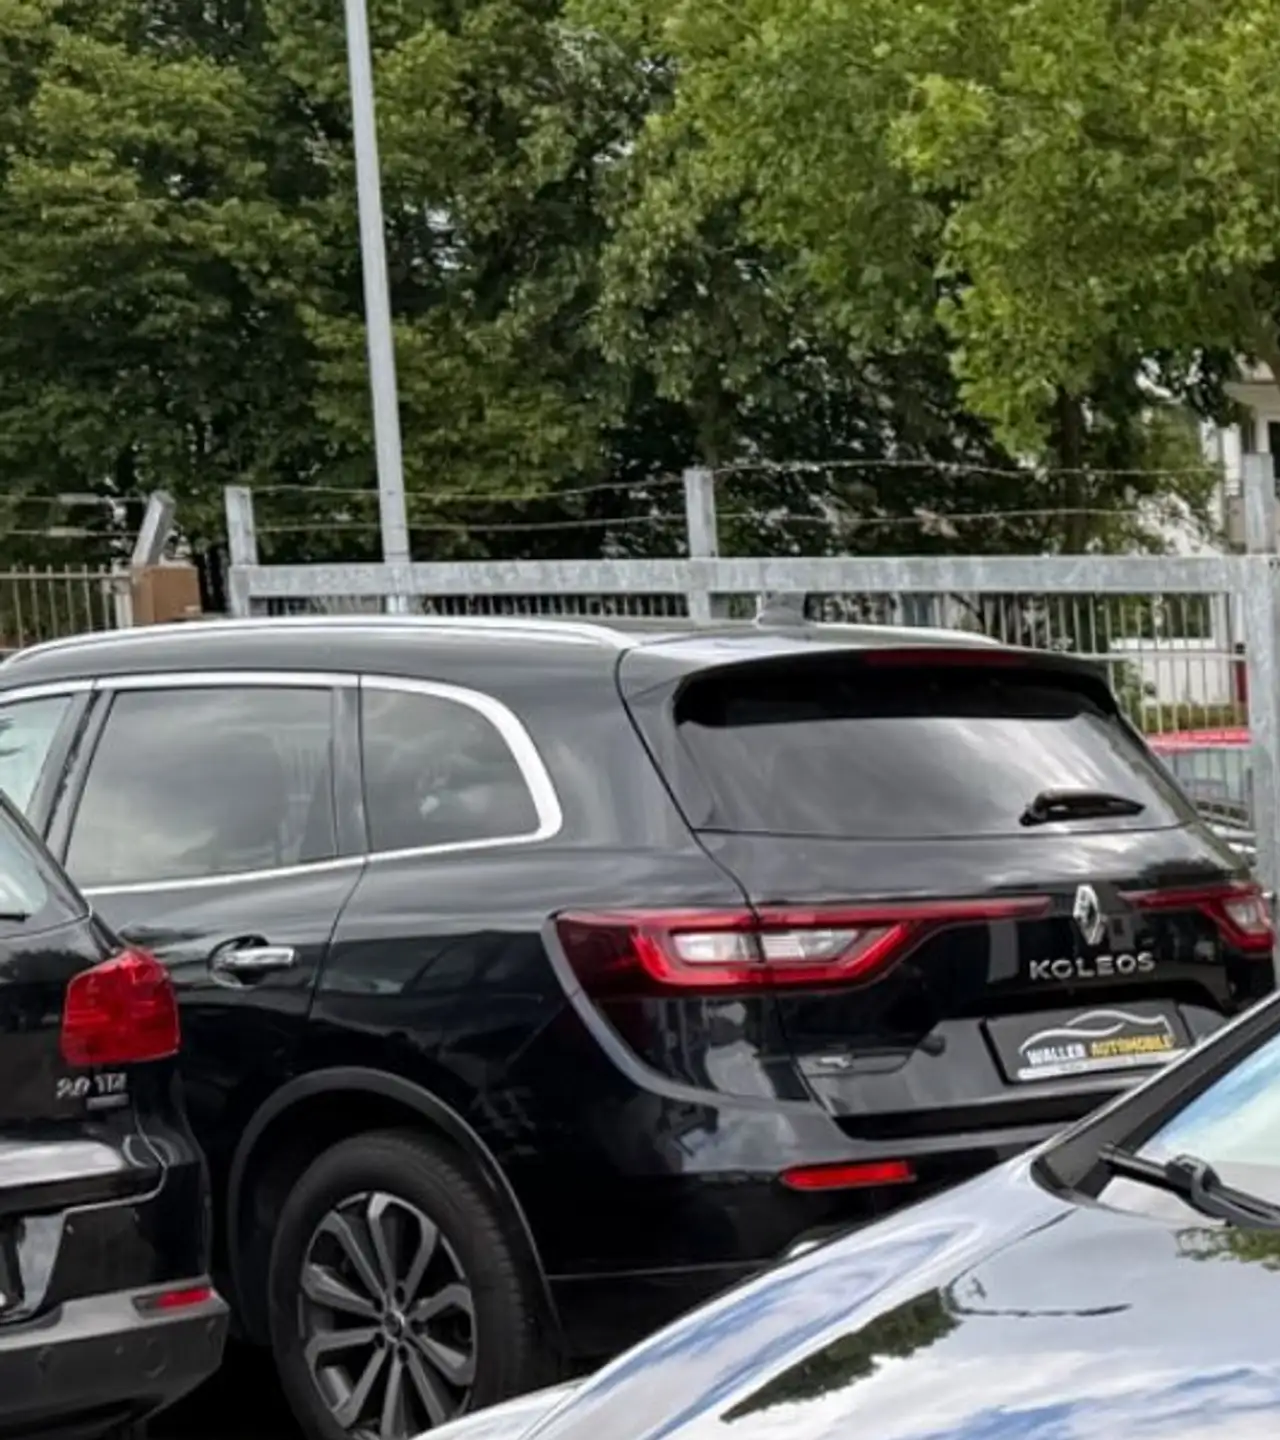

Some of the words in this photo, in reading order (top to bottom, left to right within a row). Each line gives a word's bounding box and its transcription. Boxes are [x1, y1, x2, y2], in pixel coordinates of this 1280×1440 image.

[1029, 950, 1157, 982] KOLEOS
[1027, 1042, 1088, 1066] WALLER
[1090, 1034, 1175, 1058] AUTOMOBILE
